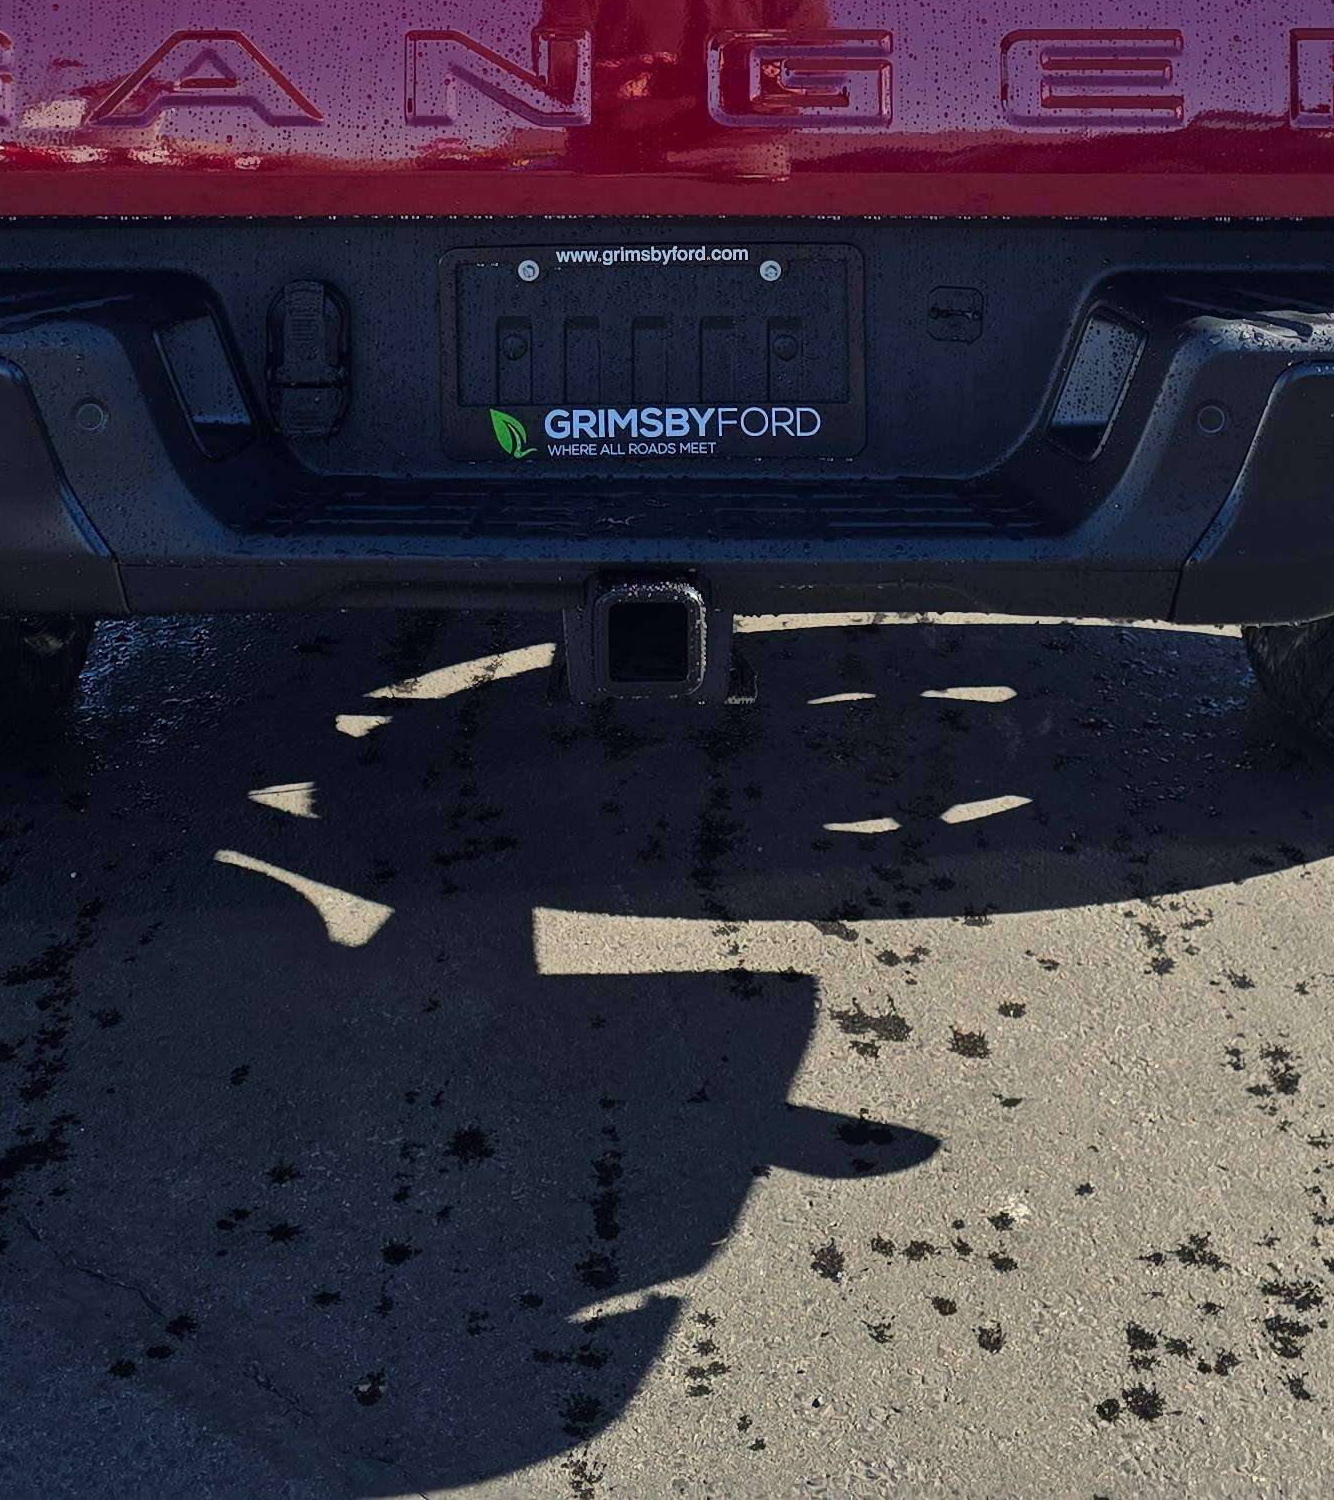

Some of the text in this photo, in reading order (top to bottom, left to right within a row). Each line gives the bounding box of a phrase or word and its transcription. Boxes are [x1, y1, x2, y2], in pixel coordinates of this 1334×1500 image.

[555, 245, 750, 266] www.grimsbyford.com
[544, 406, 822, 439] GRIMSBYFORD
[547, 440, 717, 457] WHERE ALL ROADS MEET
